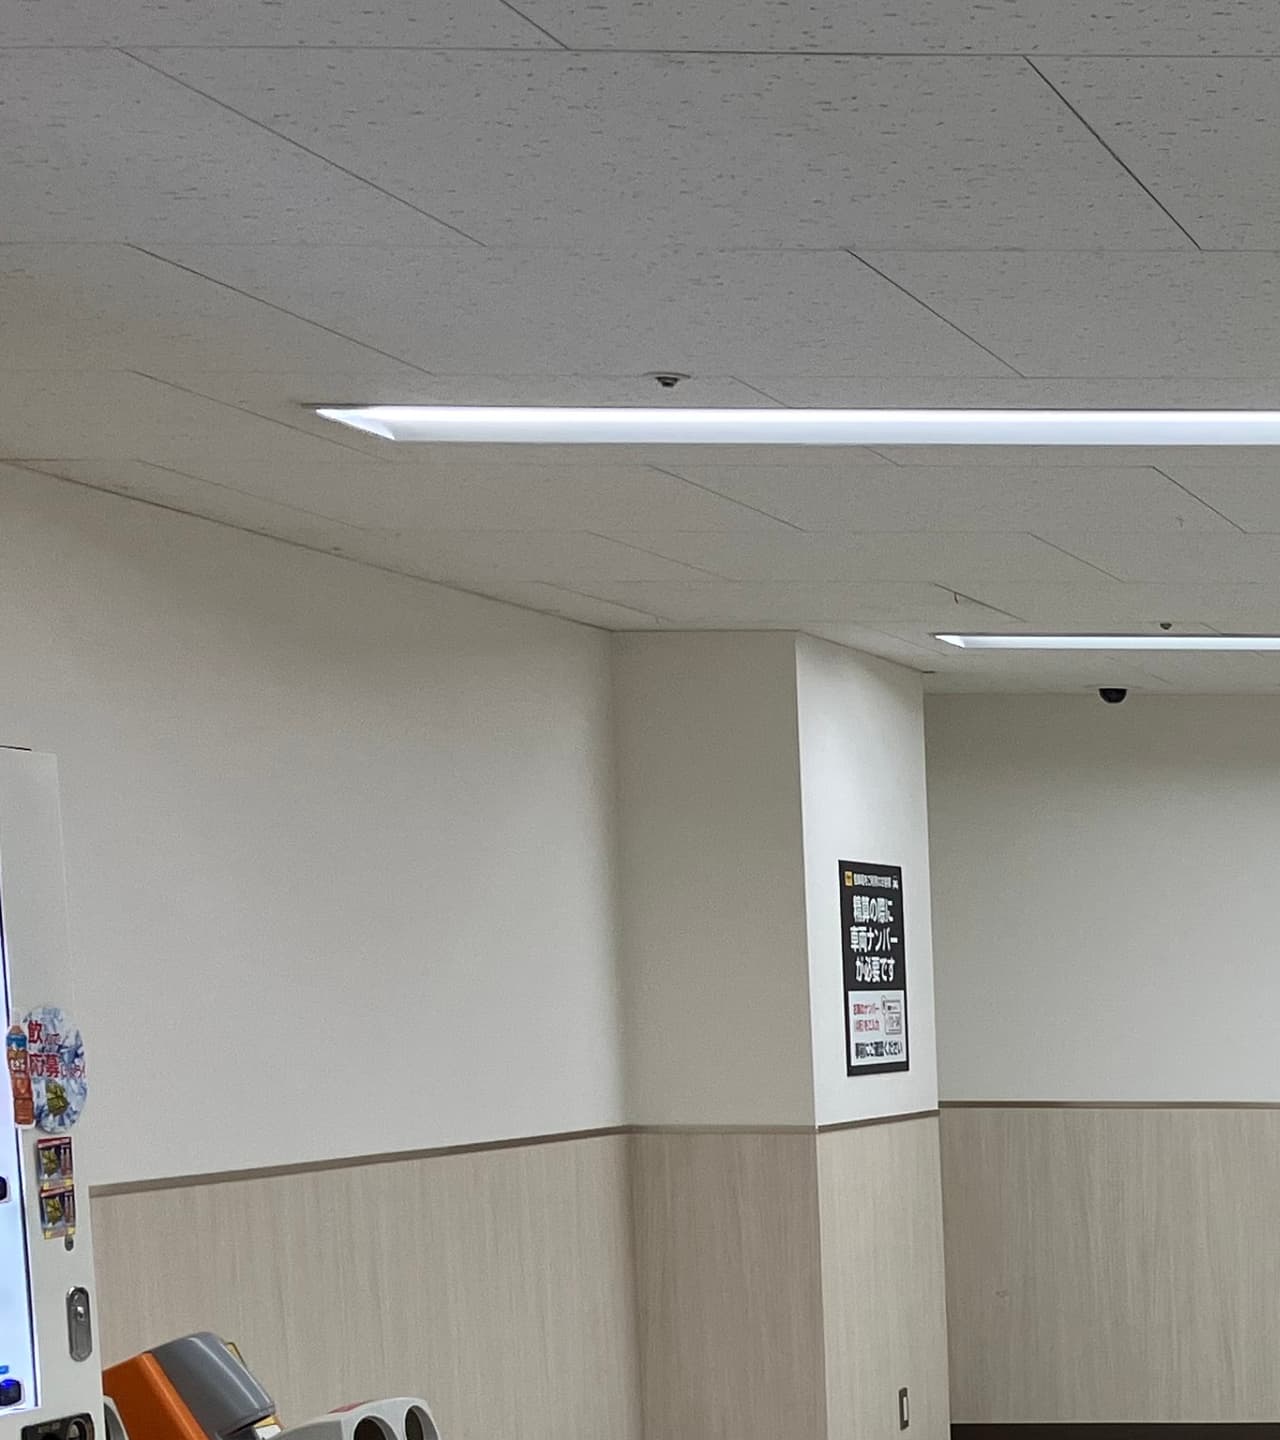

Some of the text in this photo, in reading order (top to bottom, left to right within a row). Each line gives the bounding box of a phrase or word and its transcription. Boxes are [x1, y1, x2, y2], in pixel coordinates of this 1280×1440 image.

[850, 926, 898, 953] 車両ナンバー
[855, 956, 895, 983] が必要です
